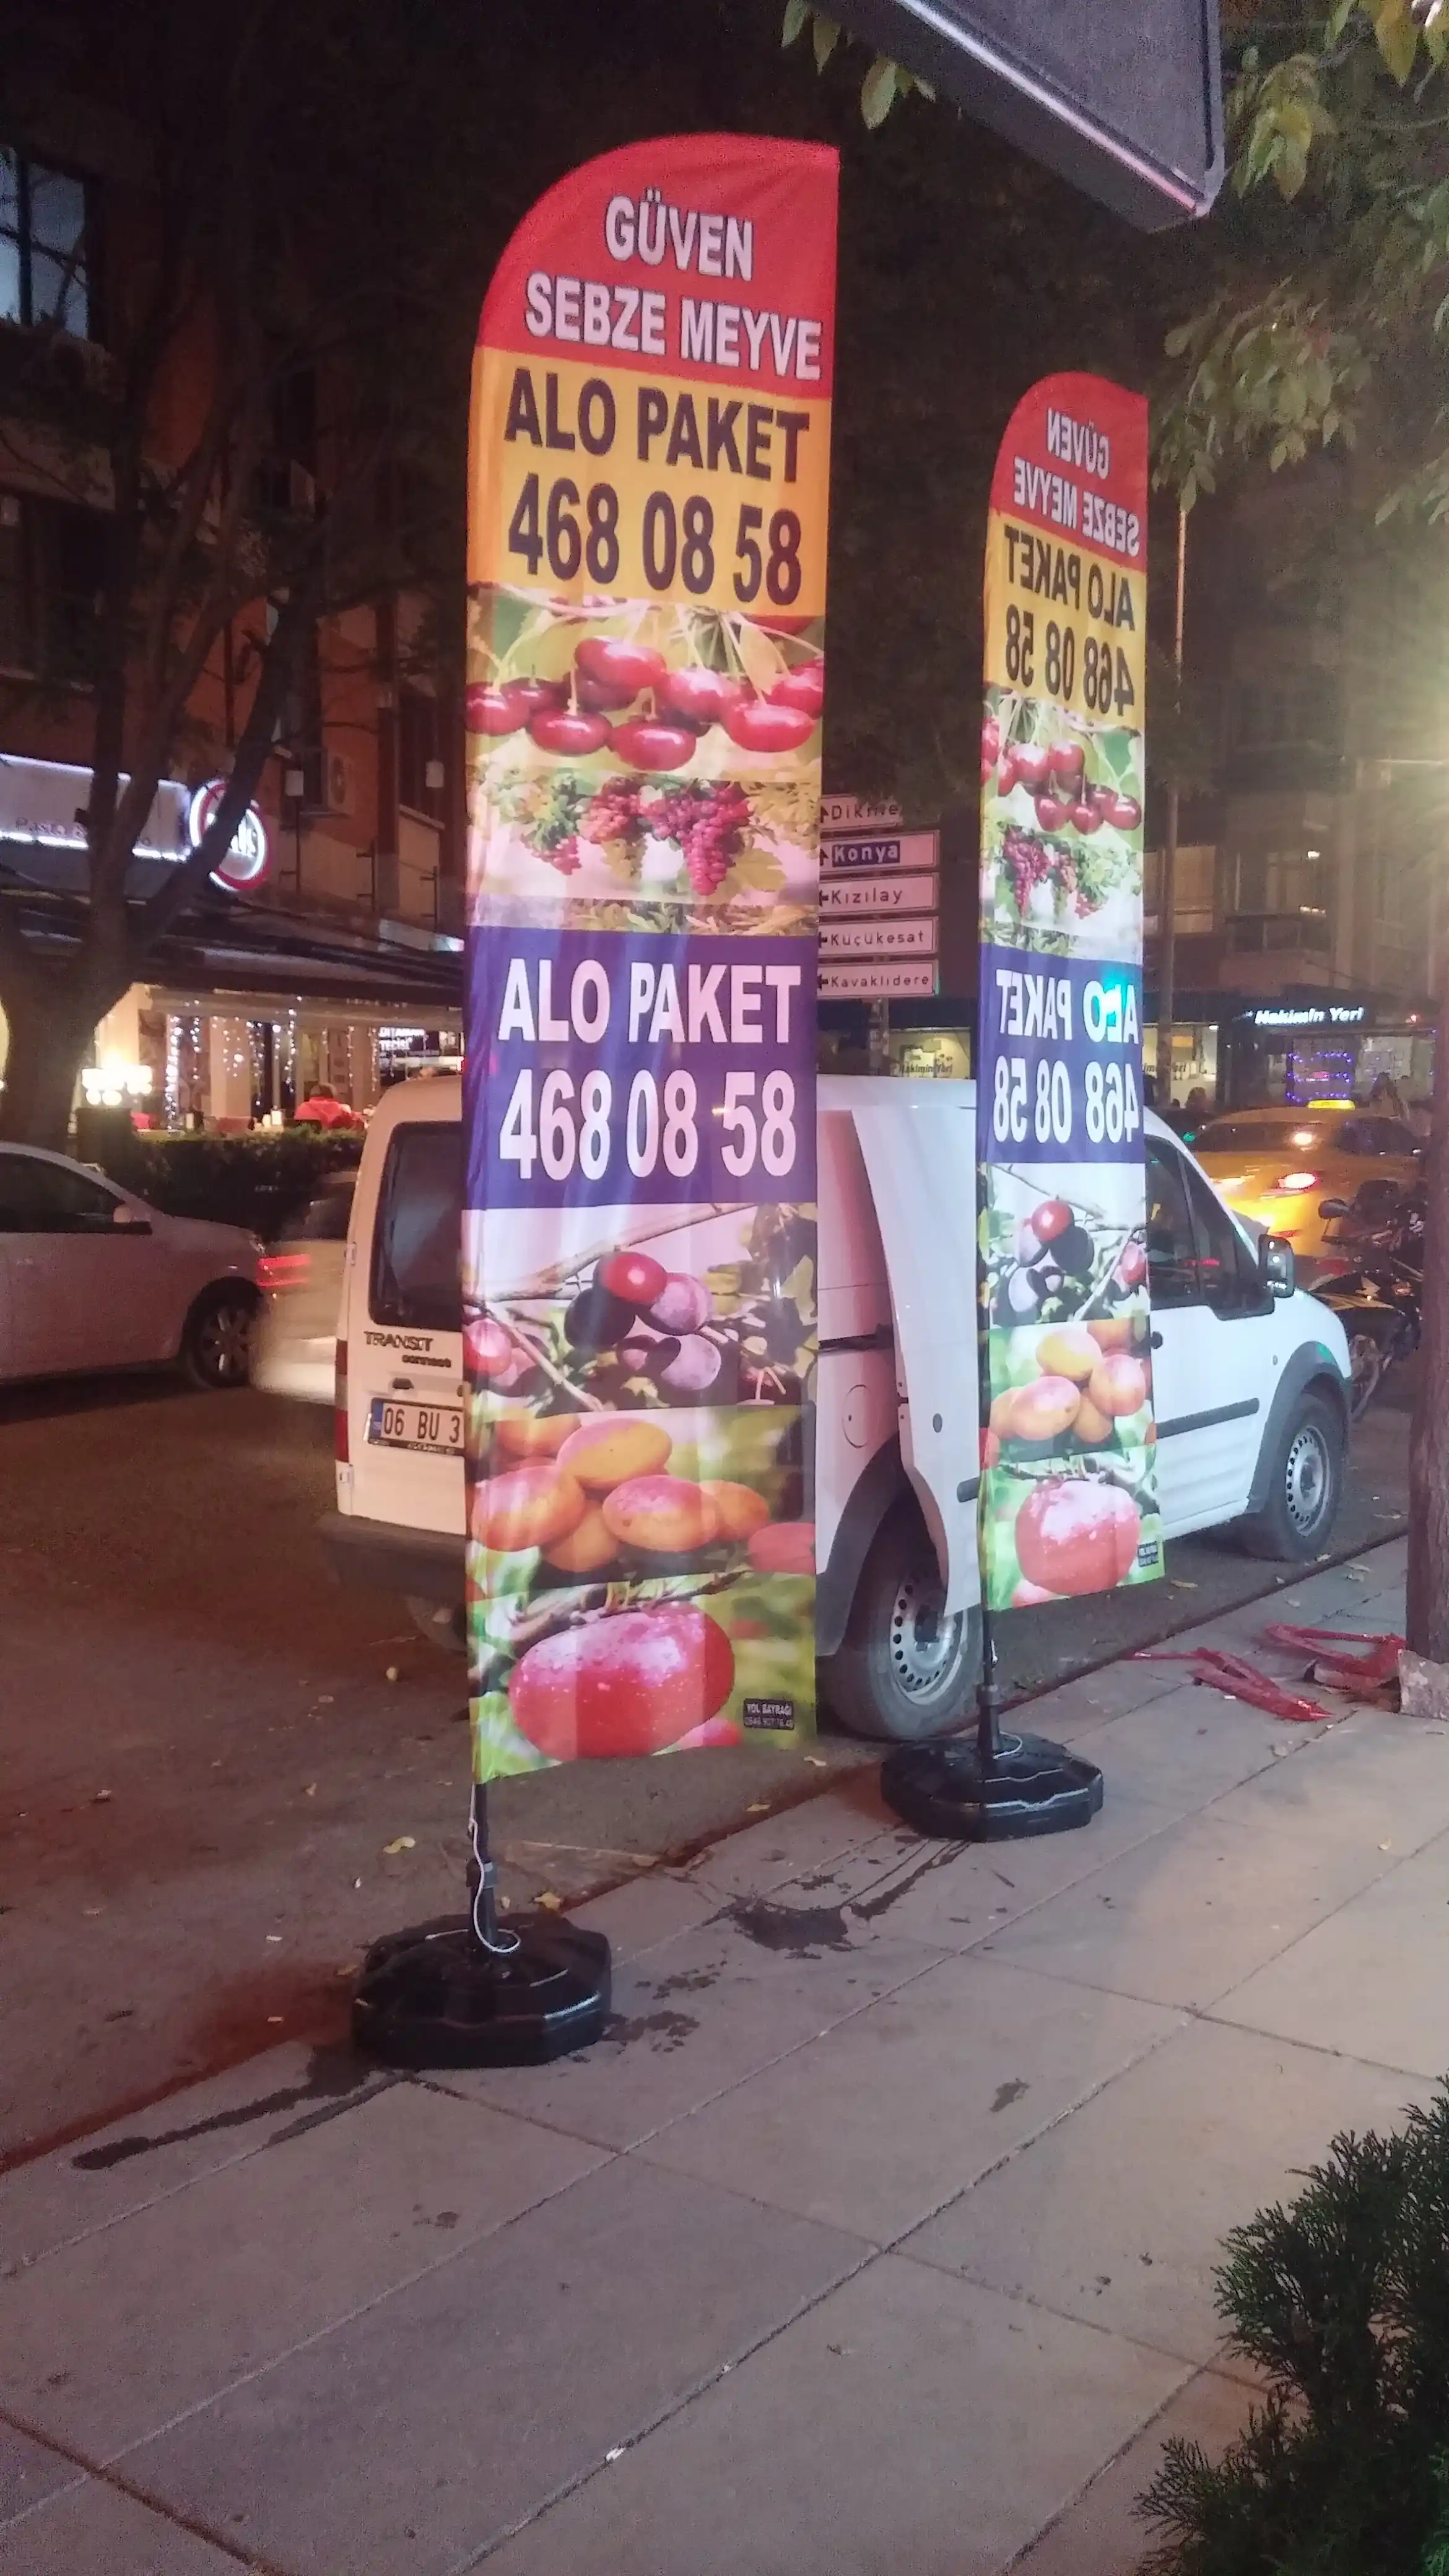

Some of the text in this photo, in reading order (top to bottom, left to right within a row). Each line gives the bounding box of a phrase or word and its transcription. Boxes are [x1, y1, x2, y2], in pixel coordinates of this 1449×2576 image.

[606, 186, 754, 281] GÜVEN
[525, 271, 822, 380] SEBZE MEYVE
[504, 368, 810, 483] ALO PAKET
[508, 471, 801, 606] 468 08 58
[834, 844, 899, 863] Konya
[831, 888, 903, 904] Kızılay
[498, 958, 801, 1043] ALO PAKET
[831, 975, 929, 988] Kavaklıdere
[1329, 1006, 1364, 1022] Yeri
[499, 1069, 796, 1180] 468 08 58
[363, 1331, 435, 1351] TRANSIT
[383, 1408, 404, 1436] 06
[417, 1411, 440, 1440] BU
